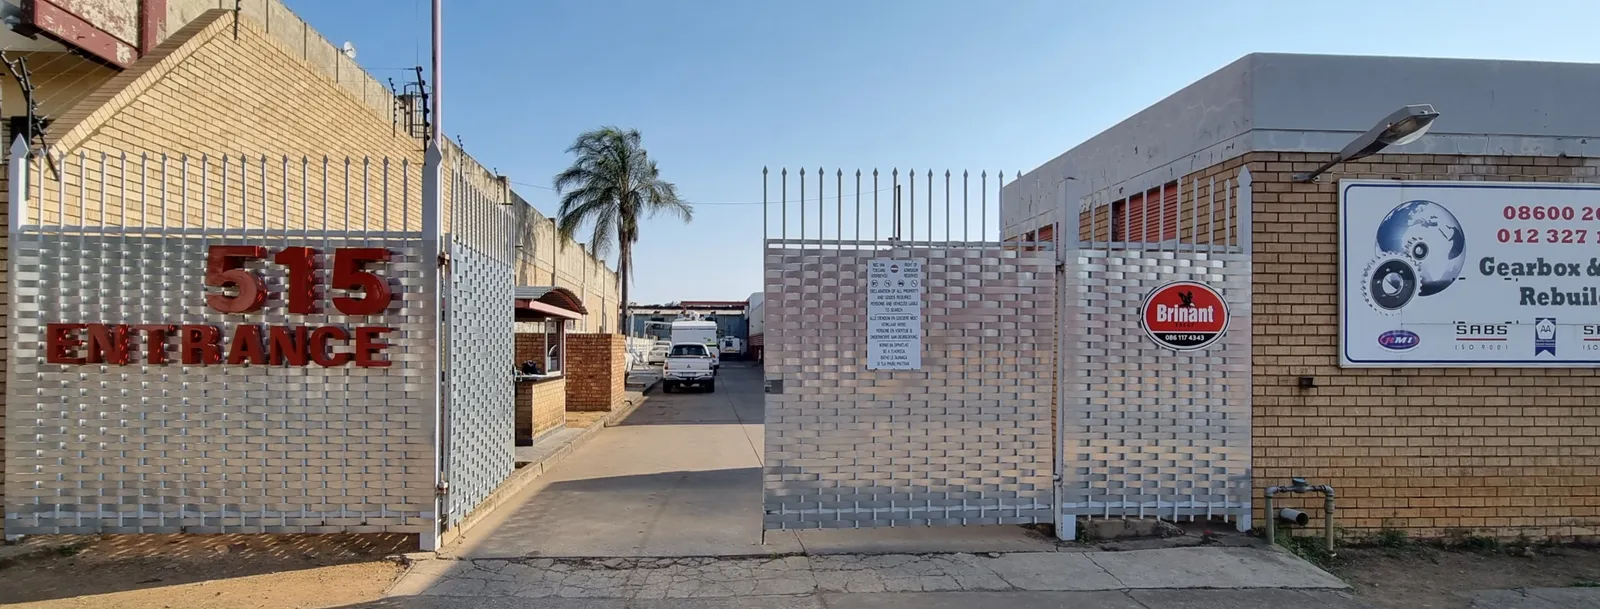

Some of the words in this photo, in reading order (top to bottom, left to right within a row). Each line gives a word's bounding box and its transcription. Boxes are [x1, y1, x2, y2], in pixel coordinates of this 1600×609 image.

[1503, 205, 1575, 221] 08600
[1497, 228, 1539, 243] 012
[1546, 229, 1588, 244] 327
[1479, 256, 1581, 277] Gearbox
[206, 245, 393, 316] 515
[1519, 286, 1600, 306] Rebuil
[1156, 303, 1214, 323] Brinant
[1456, 324, 1508, 335] SABS
[46, 323, 394, 367] ENTRANCE
